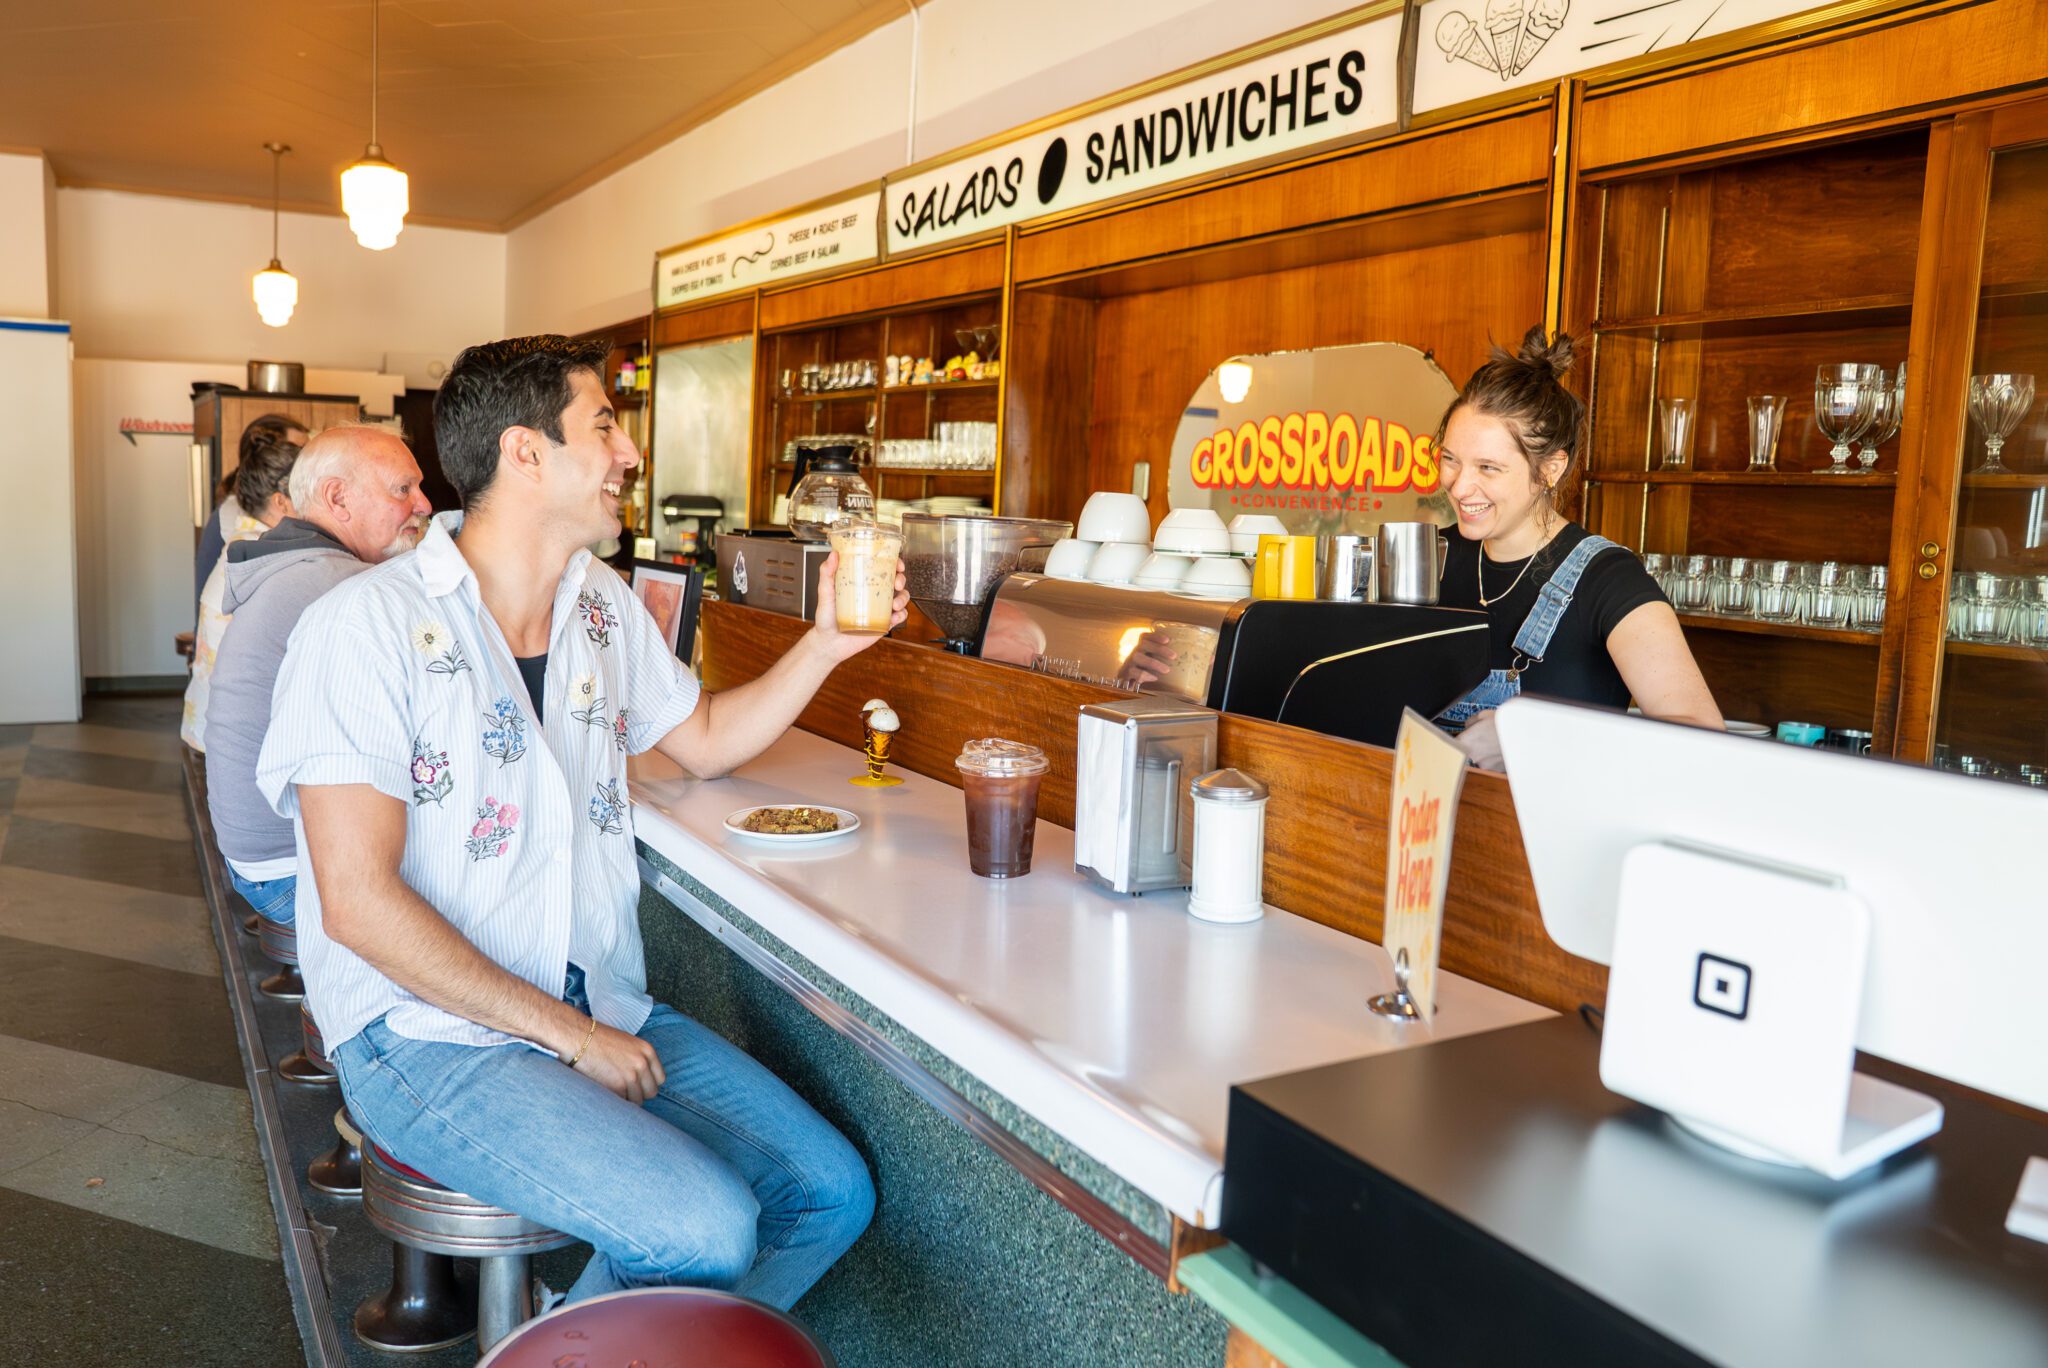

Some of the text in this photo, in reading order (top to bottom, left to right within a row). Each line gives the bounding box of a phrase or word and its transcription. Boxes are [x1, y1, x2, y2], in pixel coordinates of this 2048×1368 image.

[894, 48, 1367, 239] SALADS SANDWICHES
[769, 242, 841, 271] CORNED BEEF SALAMI
[787, 213, 858, 244] CHEESE ROAST BEEF
[1190, 410, 1441, 494] CROSSROADS
[1239, 494, 1369, 512] CONVENIENCE
[1399, 791, 1440, 848] Order
[1395, 848, 1433, 912] Here
